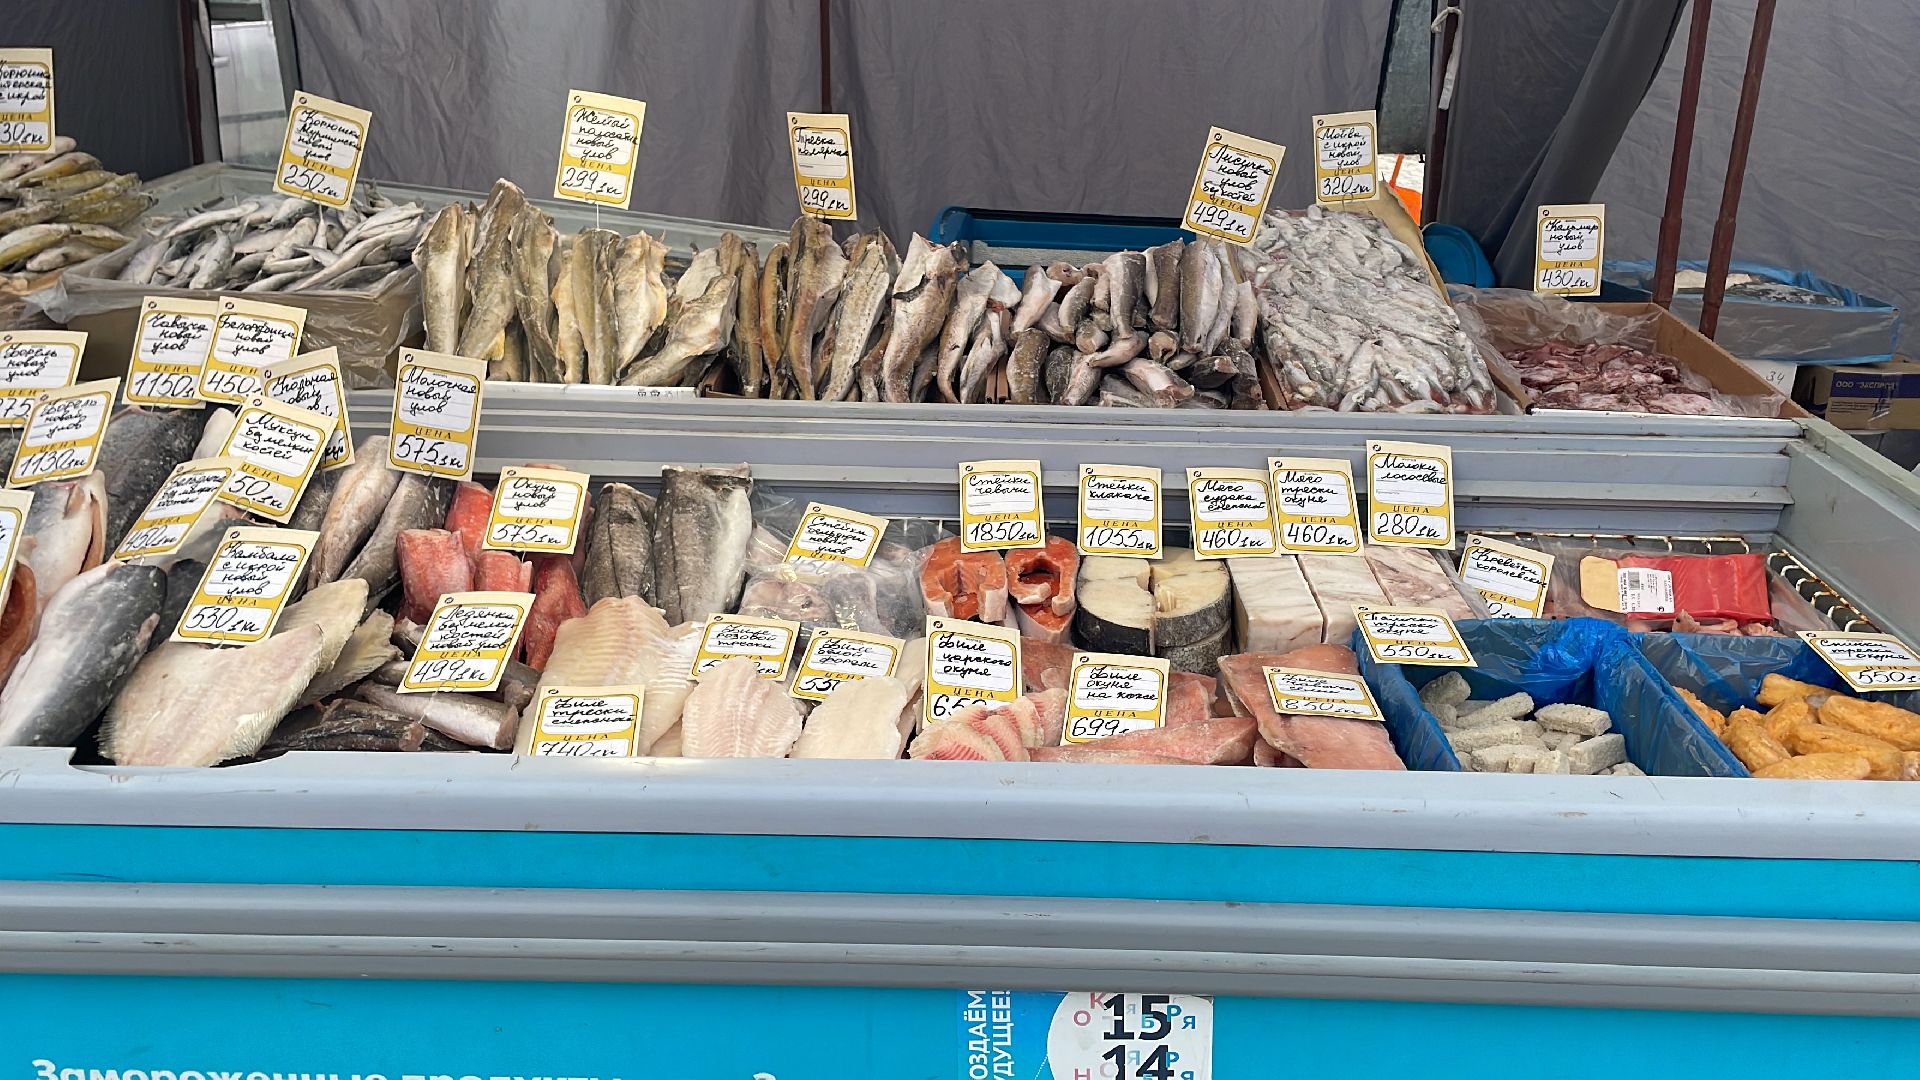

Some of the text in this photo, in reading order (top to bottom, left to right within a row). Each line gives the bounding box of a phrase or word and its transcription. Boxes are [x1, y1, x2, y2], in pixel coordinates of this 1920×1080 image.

[2, 112, 33, 121] ЦЕНА
[0, 121, 26, 143] 30
[303, 160, 335, 174] ЦЕНА
[581, 159, 612, 171] ЦЕНА
[1333, 167, 1361, 176] ЦЕНА
[284, 164, 325, 191] 250
[562, 168, 599, 191] 299
[810, 178, 837, 186] ЦЕНА
[1322, 175, 1353, 196] 320
[803, 187, 829, 208] 299
[1212, 197, 1244, 212] ЦЕНА
[1194, 202, 1229, 227] 499
[1555, 261, 1584, 269] ЦЕНА
[1542, 269, 1573, 288] 430
[154, 365, 190, 373] ЦЕНА
[135, 372, 192, 398] 1150
[207, 371, 256, 394] 450
[282, 386, 322, 404] овый
[415, 426, 451, 440] ЦЕНА
[40, 440, 77, 453] ЦЕНА
[20, 448, 75, 477] 1130
[241, 463, 281, 482] ЦЕНА
[1392, 504, 1431, 514] ЦЕНА
[516, 517, 553, 525] ЦЕНА
[984, 514, 1020, 522] ЦЕНА
[1102, 520, 1138, 528] ЦЕНА
[1217, 521, 1253, 529] ЦЕНА
[1301, 515, 1336, 524] ЦЕНА
[1377, 512, 1420, 536] 280
[492, 523, 538, 542] 575
[970, 521, 1024, 542] 1850
[1086, 526, 1143, 548] 1055
[1202, 528, 1242, 549] 460
[1287, 522, 1328, 543] 460
[811, 551, 845, 563] ЦЕНА
[216, 595, 257, 606] ЦЕНА
[1480, 590, 1517, 604] ЦЕНА
[185, 605, 239, 629] 530
[1395, 639, 1438, 647] ЦЕНА
[440, 650, 482, 659] ЦЕНА
[1382, 644, 1430, 658] 550
[413, 659, 466, 684] 499
[1858, 670, 1905, 685] 550
[953, 687, 995, 699] ЦЕНА
[1284, 698, 1335, 710] 850
[1094, 710, 1136, 718] ЦЕНА
[1072, 716, 1121, 737] 699
[563, 733, 609, 743] ЦЕНА
[541, 741, 590, 758] 740
[1102, 994, 1172, 1041] 15
[963, 990, 988, 1080] ОЗДАЁМ
[1101, 1044, 1175, 1080] 14
